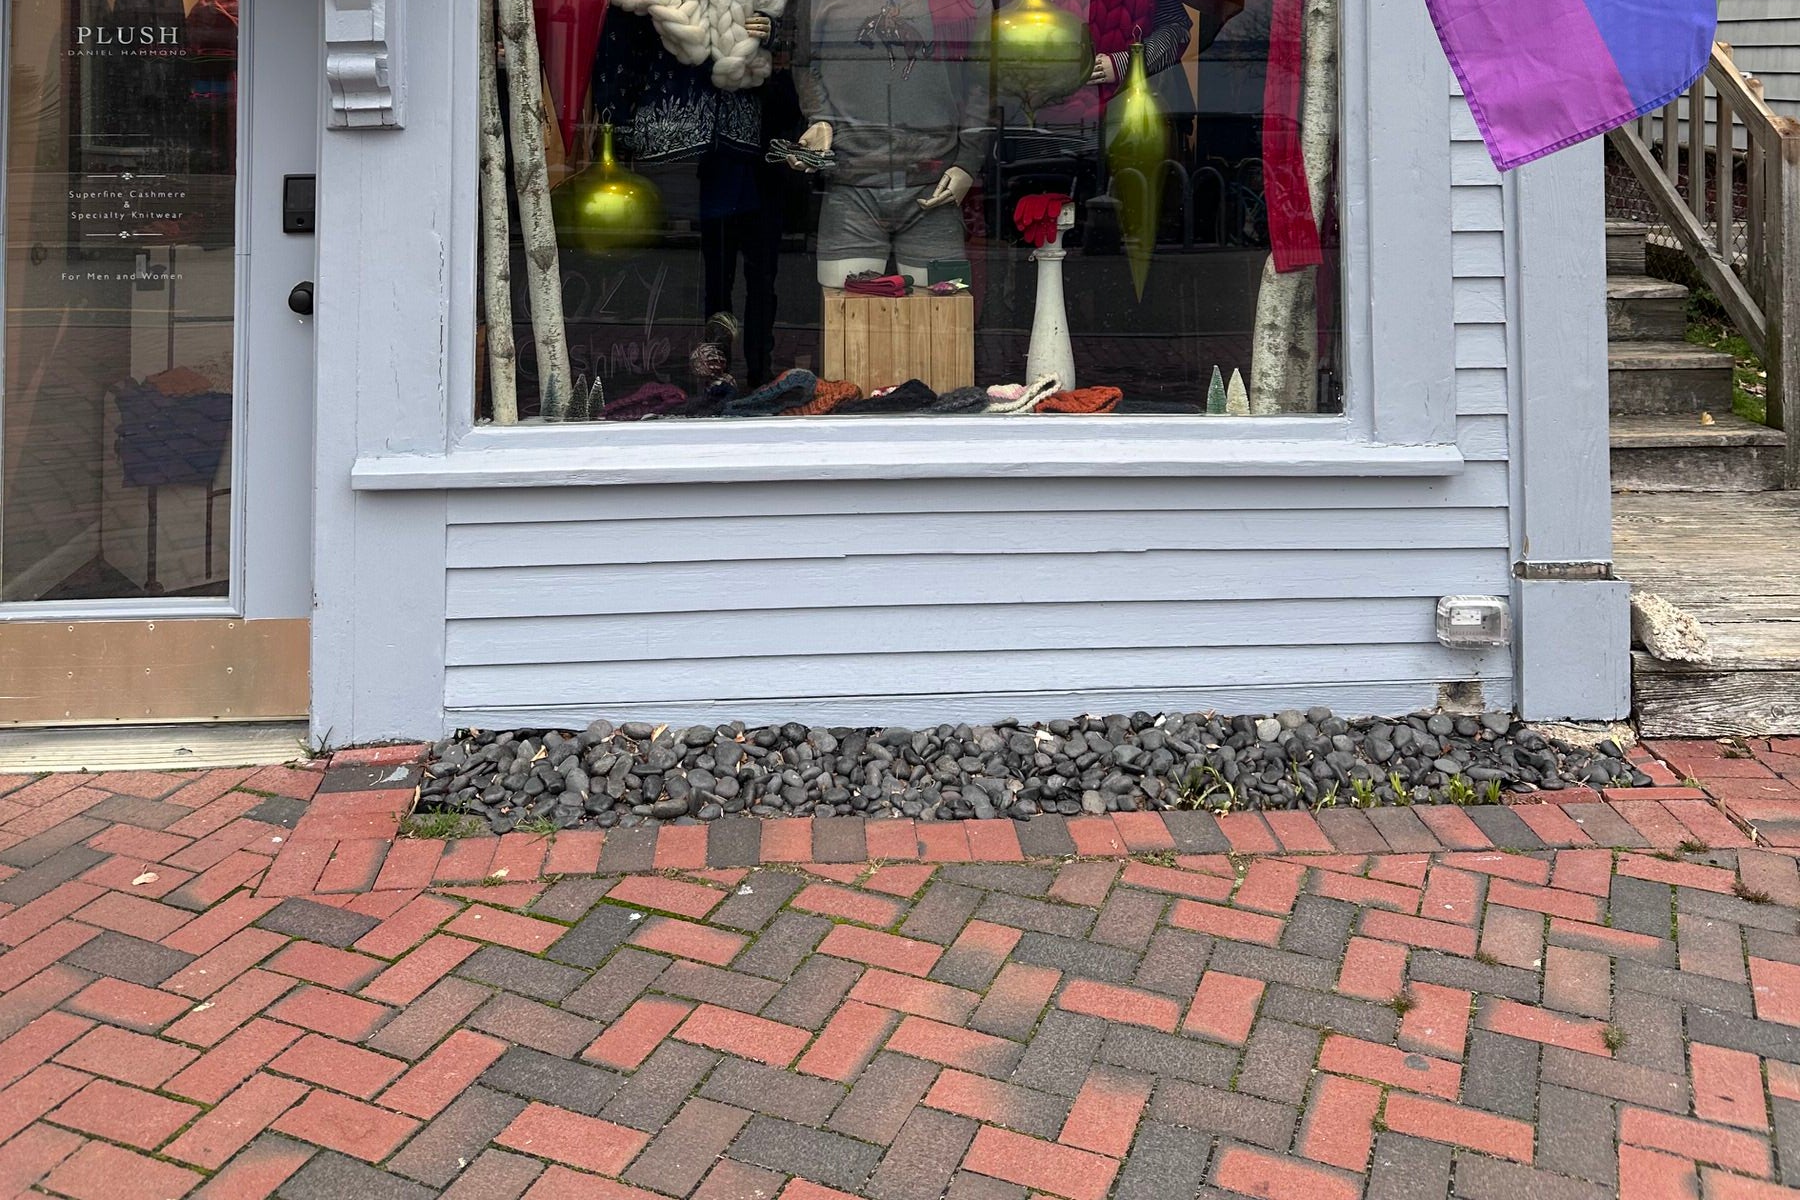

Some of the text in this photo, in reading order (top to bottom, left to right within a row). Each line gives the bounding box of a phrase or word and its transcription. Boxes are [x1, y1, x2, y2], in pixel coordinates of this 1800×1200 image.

[76, 26, 179, 45] PLUSH
[68, 190, 186, 200] Superfine Cashmere
[71, 211, 183, 221] Specialty Knitwear
[61, 272, 183, 281] For Men and Women
